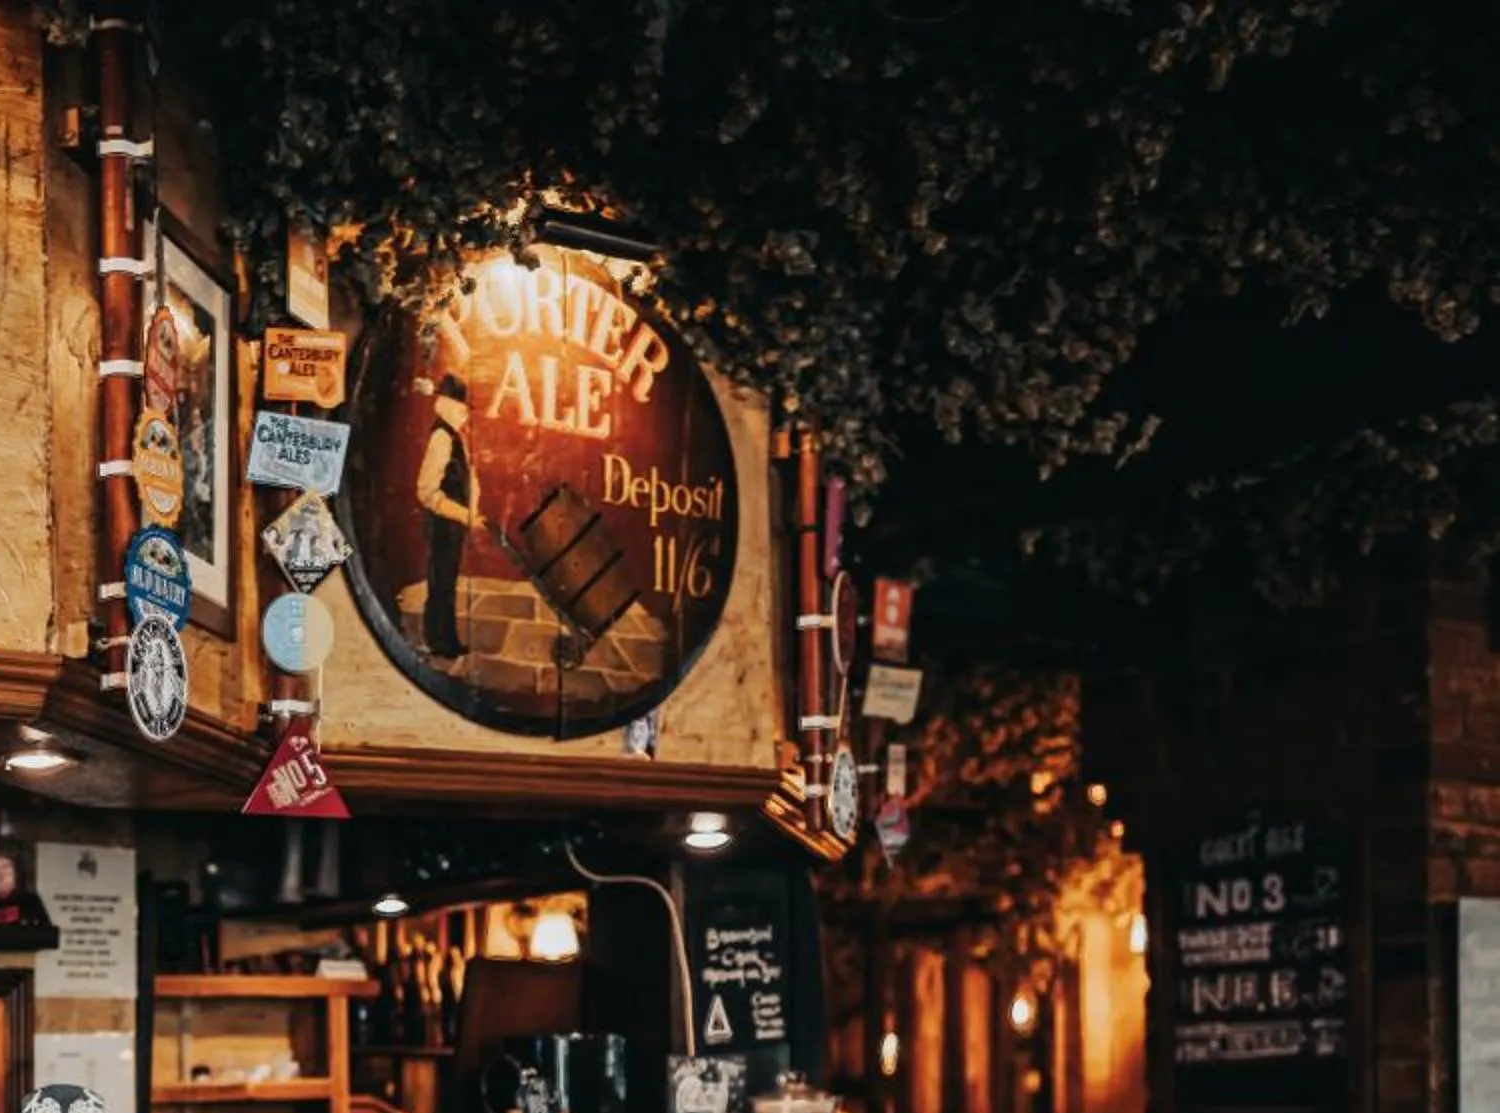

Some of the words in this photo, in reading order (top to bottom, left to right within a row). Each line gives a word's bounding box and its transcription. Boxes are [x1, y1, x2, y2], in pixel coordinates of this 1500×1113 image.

[268, 343, 342, 362] CANTERBURY
[486, 348, 613, 441] ALE
[602, 453, 725, 527] Deposit
